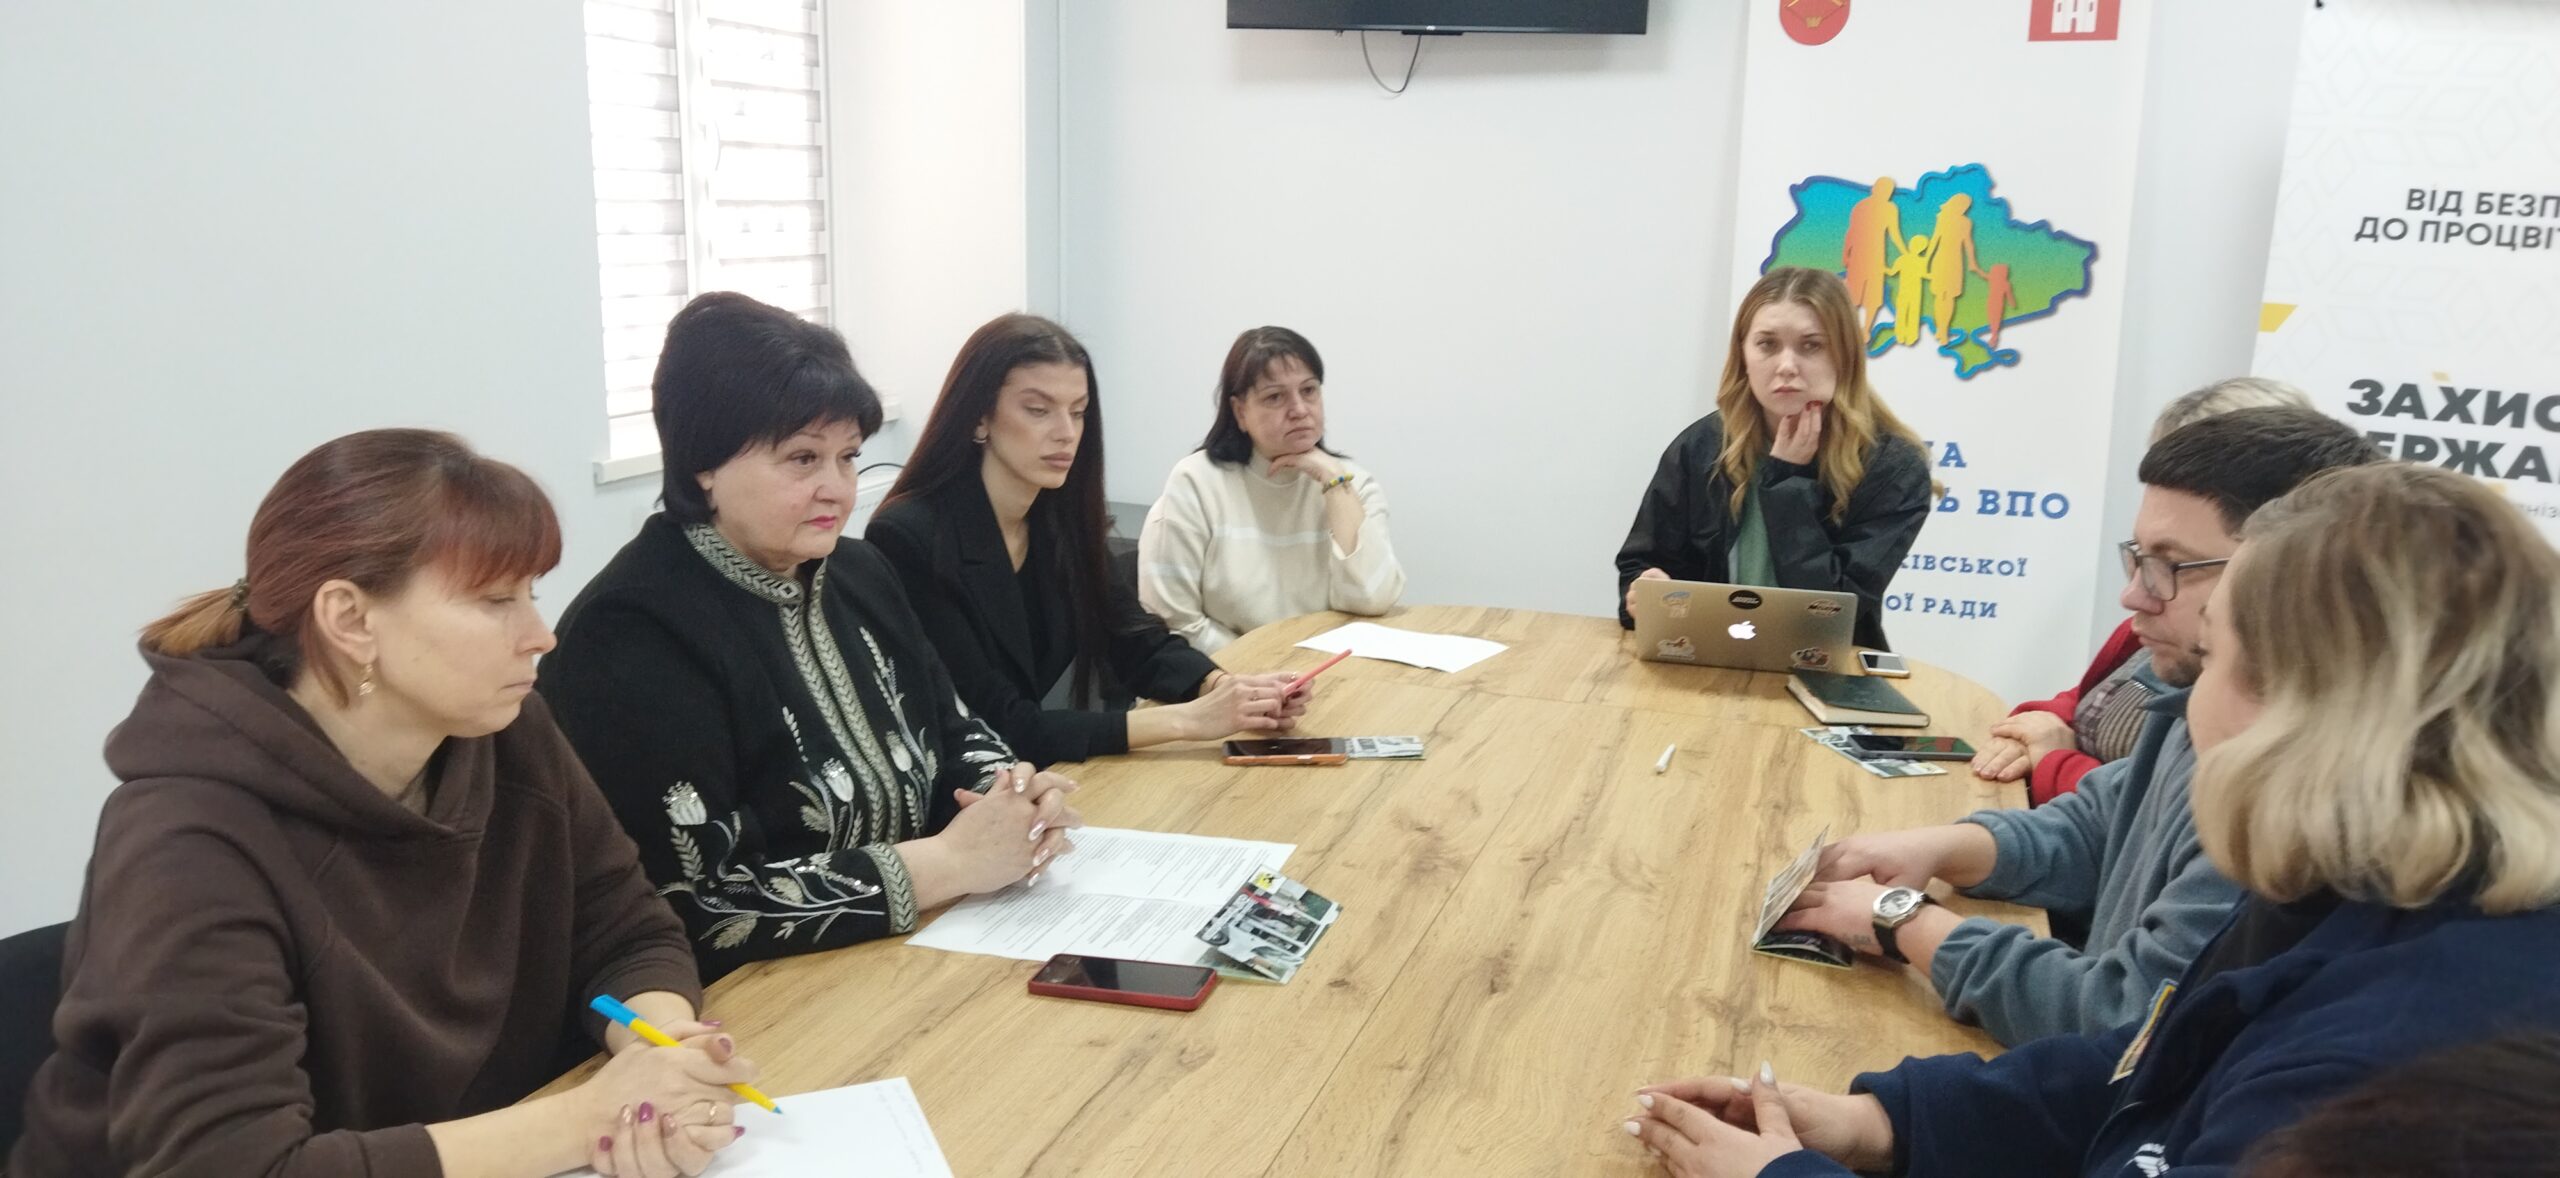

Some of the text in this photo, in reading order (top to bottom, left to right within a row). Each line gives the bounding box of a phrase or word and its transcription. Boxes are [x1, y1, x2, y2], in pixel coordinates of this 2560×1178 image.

[2406, 188, 2463, 217] ВІД
[2354, 216, 2560, 251] ДО ПРОЦВІ
[1976, 488, 2070, 520] ВПО
[1922, 597, 1998, 620] РАДИ
